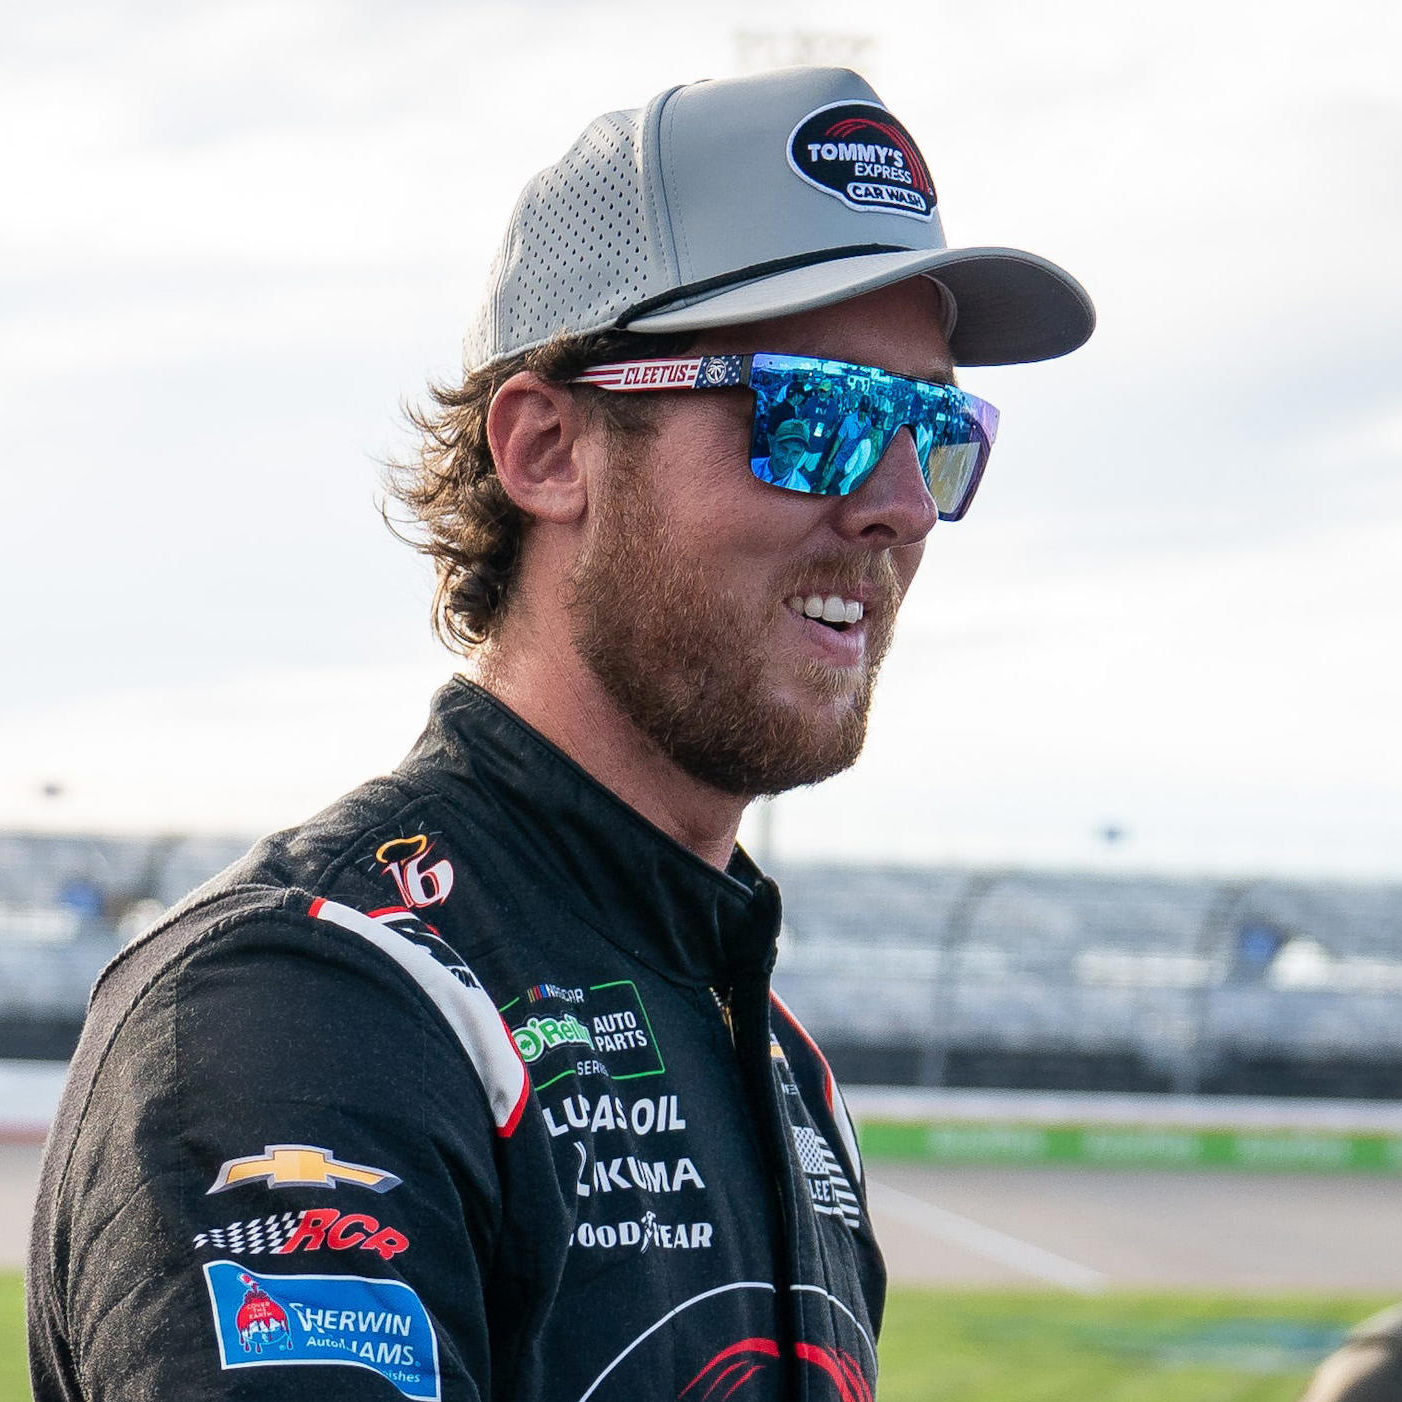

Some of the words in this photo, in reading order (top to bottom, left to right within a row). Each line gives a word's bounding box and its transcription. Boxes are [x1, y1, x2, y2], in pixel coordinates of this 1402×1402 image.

[808, 143, 904, 168] TOMMY'S
[855, 162, 912, 184] EXPRESS
[853, 185, 885, 200] CAR
[886, 188, 925, 209] WASH
[624, 364, 688, 385] CLEETUS
[593, 1011, 637, 1034] AUTO
[595, 1030, 648, 1053] PARTS
[631, 1095, 687, 1136] OIL
[281, 1208, 409, 1260] RCR
